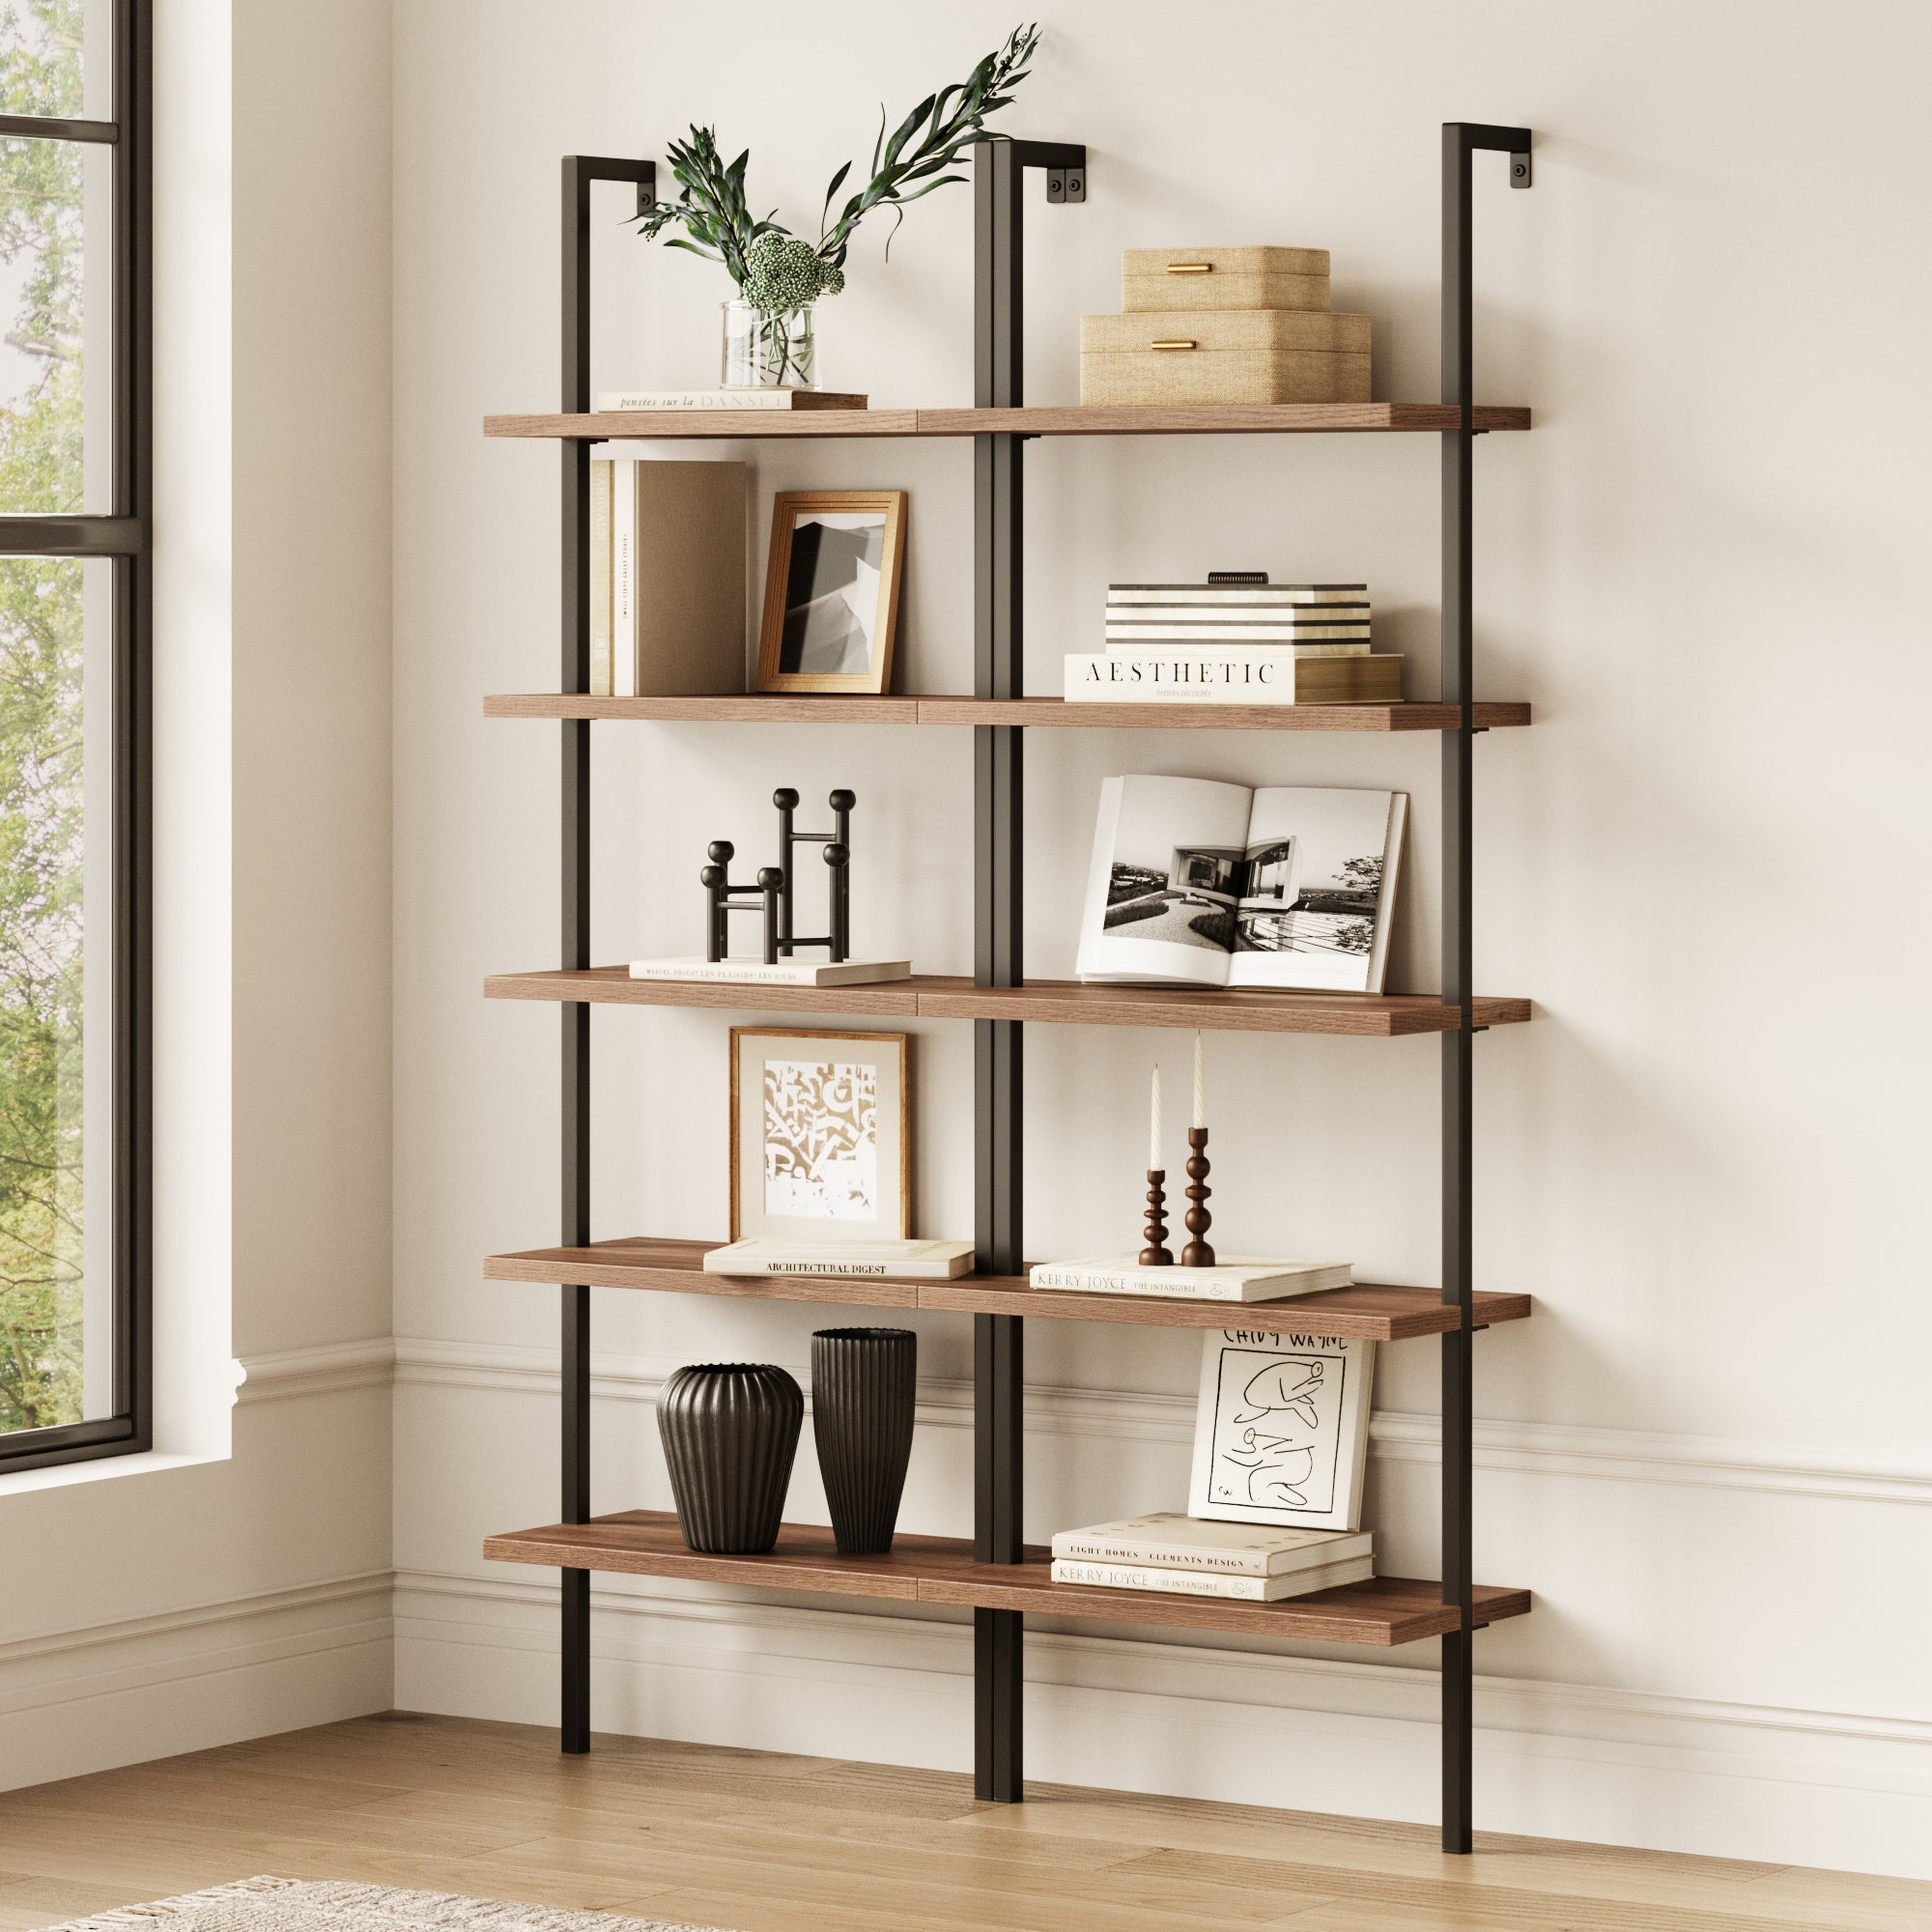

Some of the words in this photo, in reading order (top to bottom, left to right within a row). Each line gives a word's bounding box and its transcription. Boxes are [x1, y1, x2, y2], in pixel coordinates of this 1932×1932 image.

[620, 395, 657, 409] pensées
[662, 396, 679, 407] sur
[683, 395, 695, 407] la
[1086, 662, 1274, 684] AESTHETIC
[700, 969, 715, 978] LES
[766, 1263, 850, 1273] ARCHITECTURAL
[852, 1264, 887, 1274] DIGEST
[1038, 1273, 1082, 1287] KERRY
[1088, 1275, 1126, 1290] JOYCE
[1150, 1283, 1196, 1293] INTANGIBLE
[1070, 1546, 1100, 1555] EIGHT
[1105, 1549, 1139, 1558] HOMES
[1150, 1553, 1203, 1565] CLEMENTS
[1208, 1558, 1244, 1568] DESIGN
[1060, 1567, 1103, 1582] KERRY
[1110, 1571, 1148, 1586] JOYCE
[1172, 1579, 1218, 1592] INTANGIBLE
